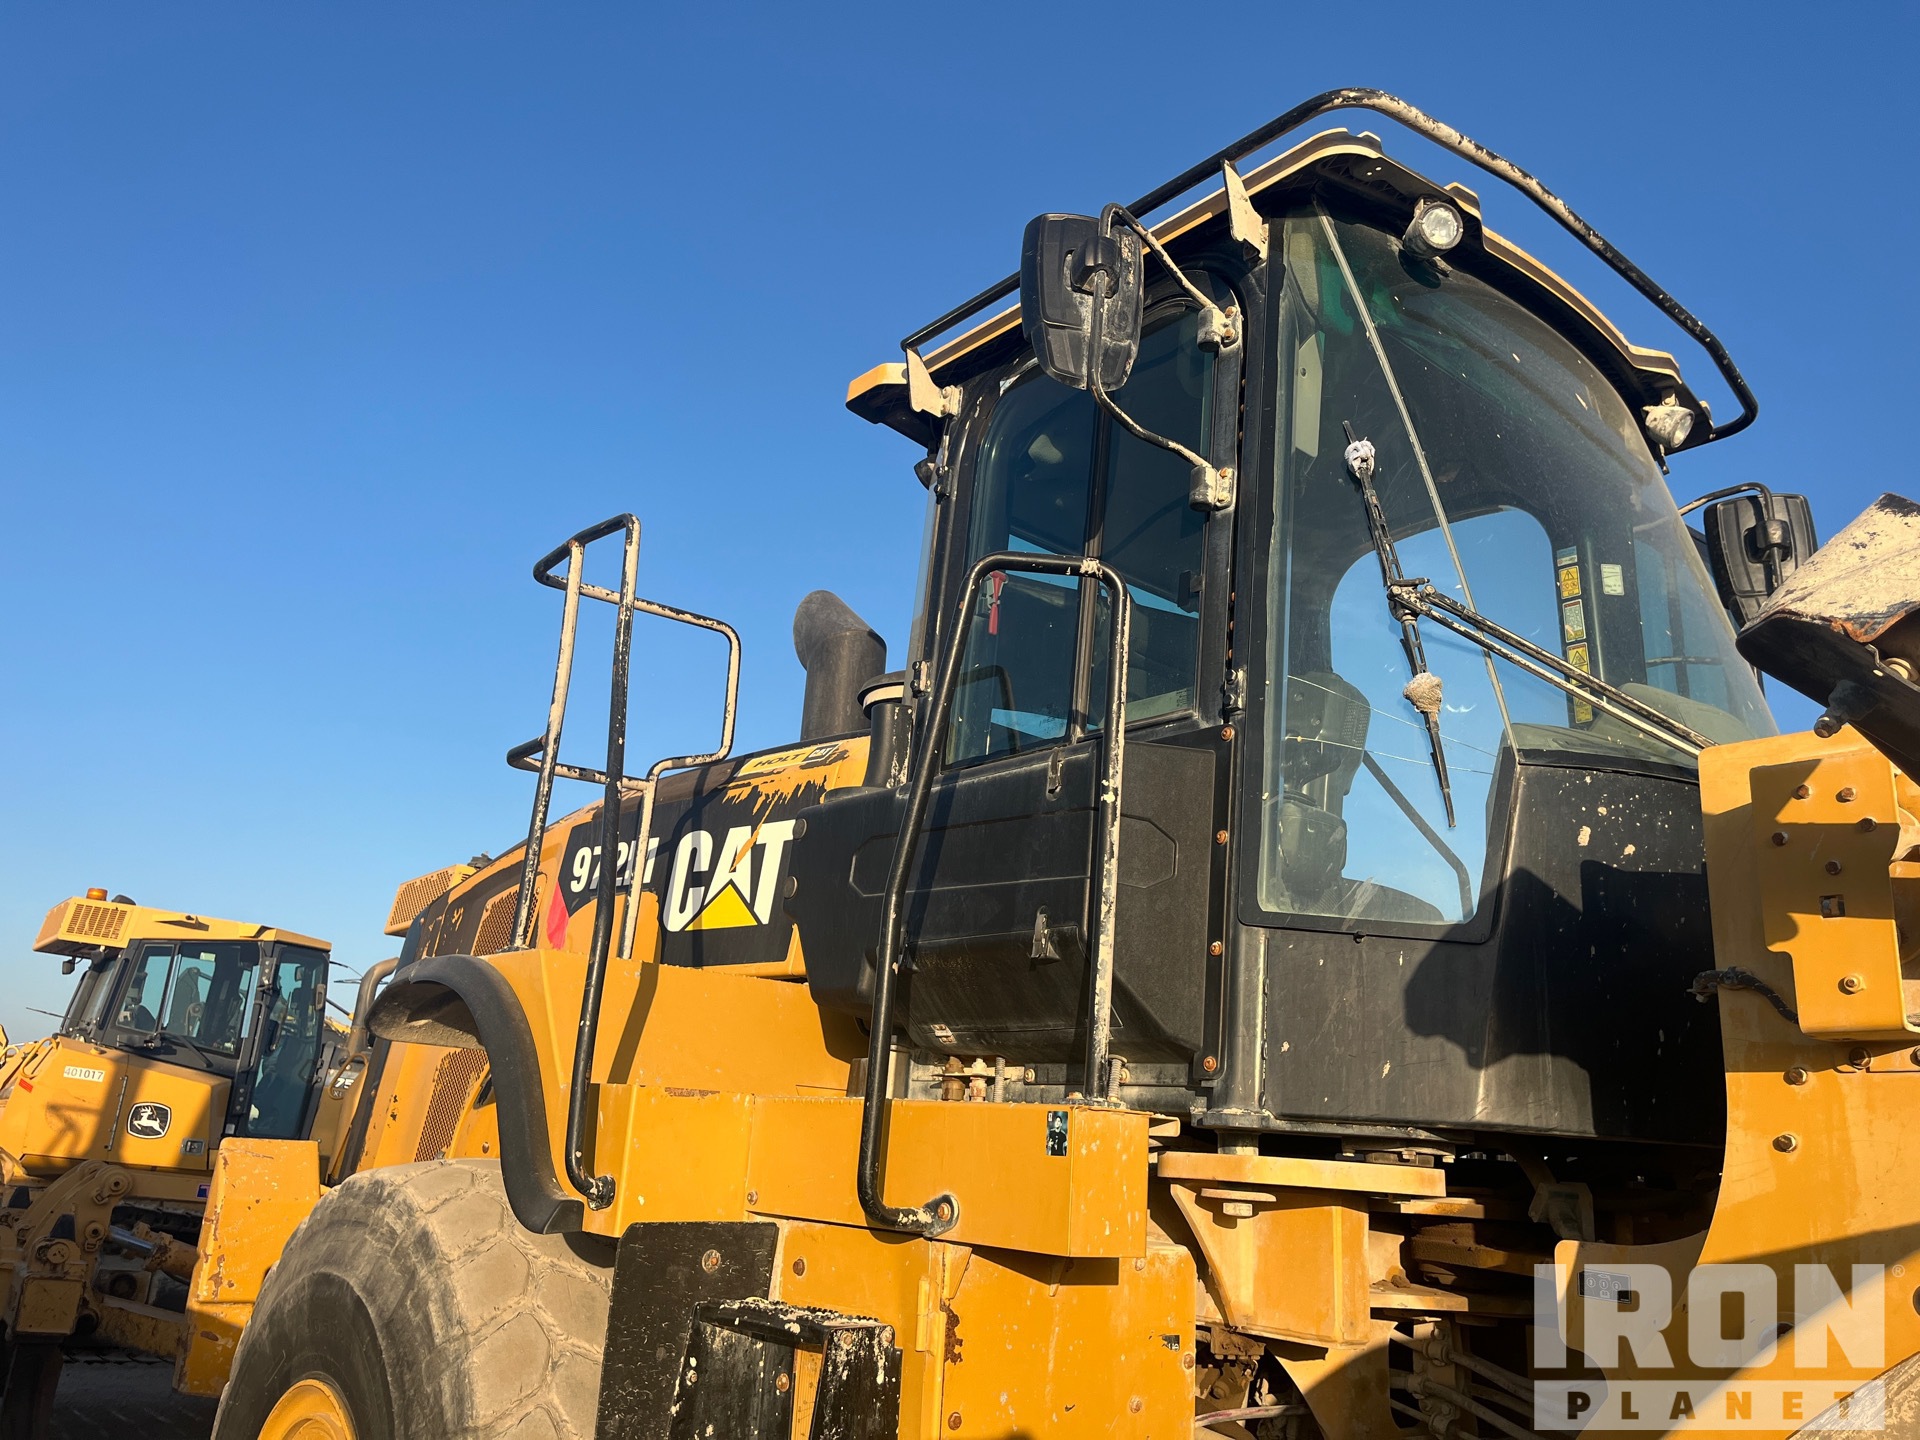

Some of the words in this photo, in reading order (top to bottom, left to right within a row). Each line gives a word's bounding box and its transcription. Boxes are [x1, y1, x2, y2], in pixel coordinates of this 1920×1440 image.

[753, 753, 805, 768] HOLT
[808, 746, 834, 758] CAT
[663, 819, 797, 932] CAT
[64, 1067, 104, 1081] 401017
